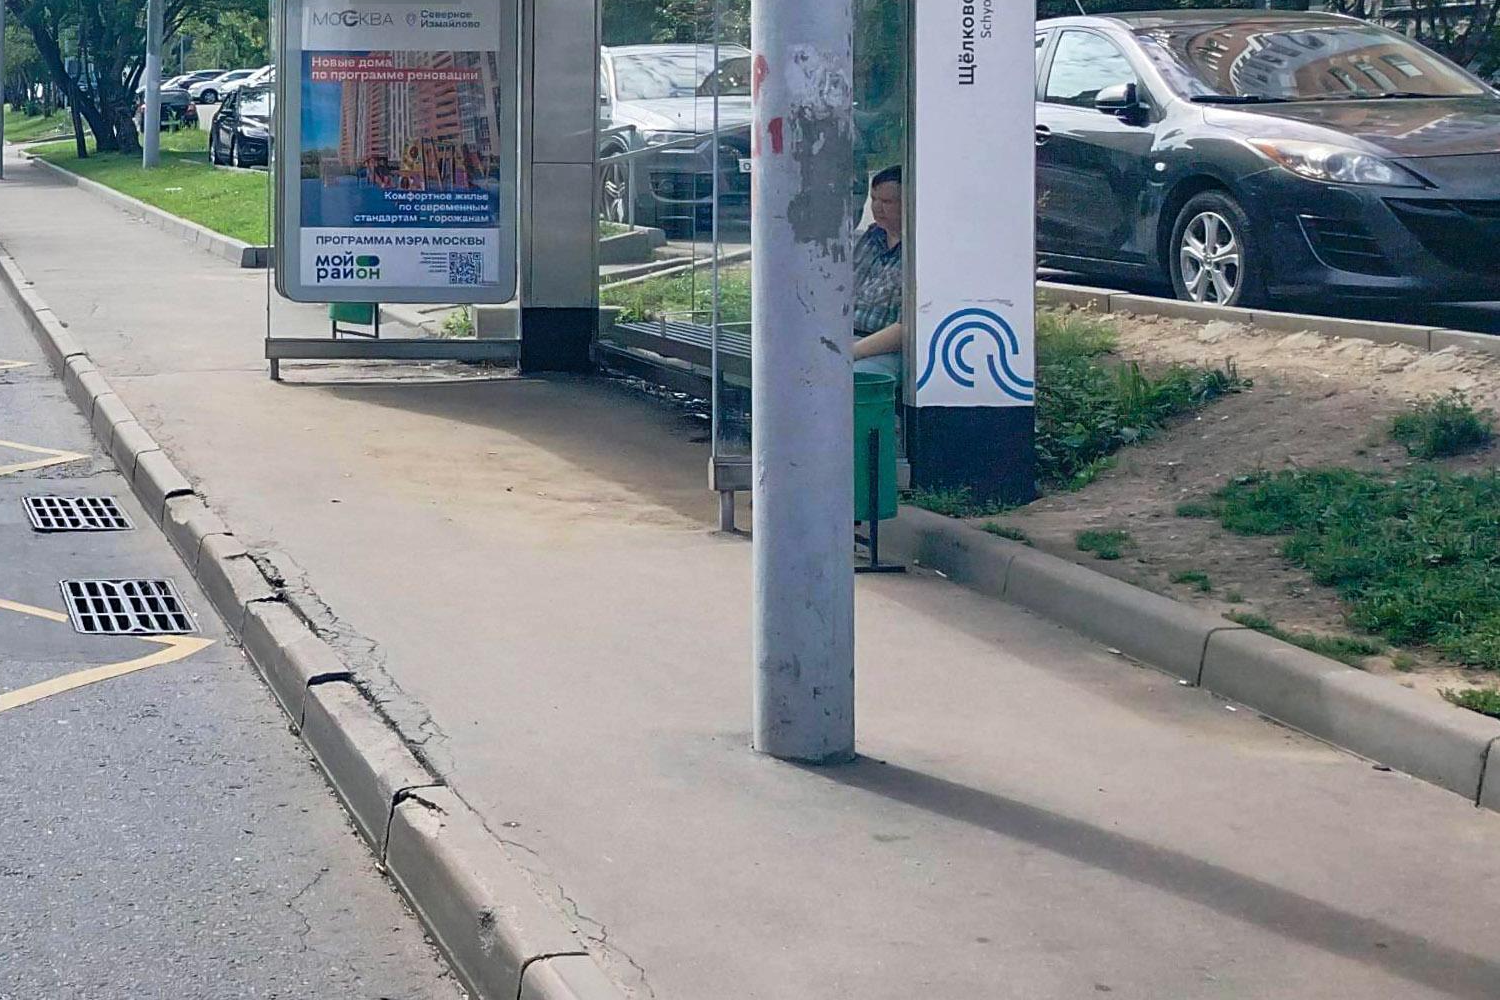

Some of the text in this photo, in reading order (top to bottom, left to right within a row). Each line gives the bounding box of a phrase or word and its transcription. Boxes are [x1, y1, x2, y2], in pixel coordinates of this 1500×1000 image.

[312, 9, 394, 27] МОСКВА
[420, 9, 473, 20] Северное
[420, 18, 481, 29] Измайлово
[311, 56, 393, 69] Новые дома
[312, 71, 478, 83] по программе реновации
[384, 191, 452, 202] Комфортное
[399, 203, 489, 213] по современным
[354, 214, 418, 223] стандартам
[429, 214, 489, 224] горожанам
[315, 235, 486, 246] ПРОГРАММА МЭРА МОСКВЫ
[315, 251, 355, 267] мой
